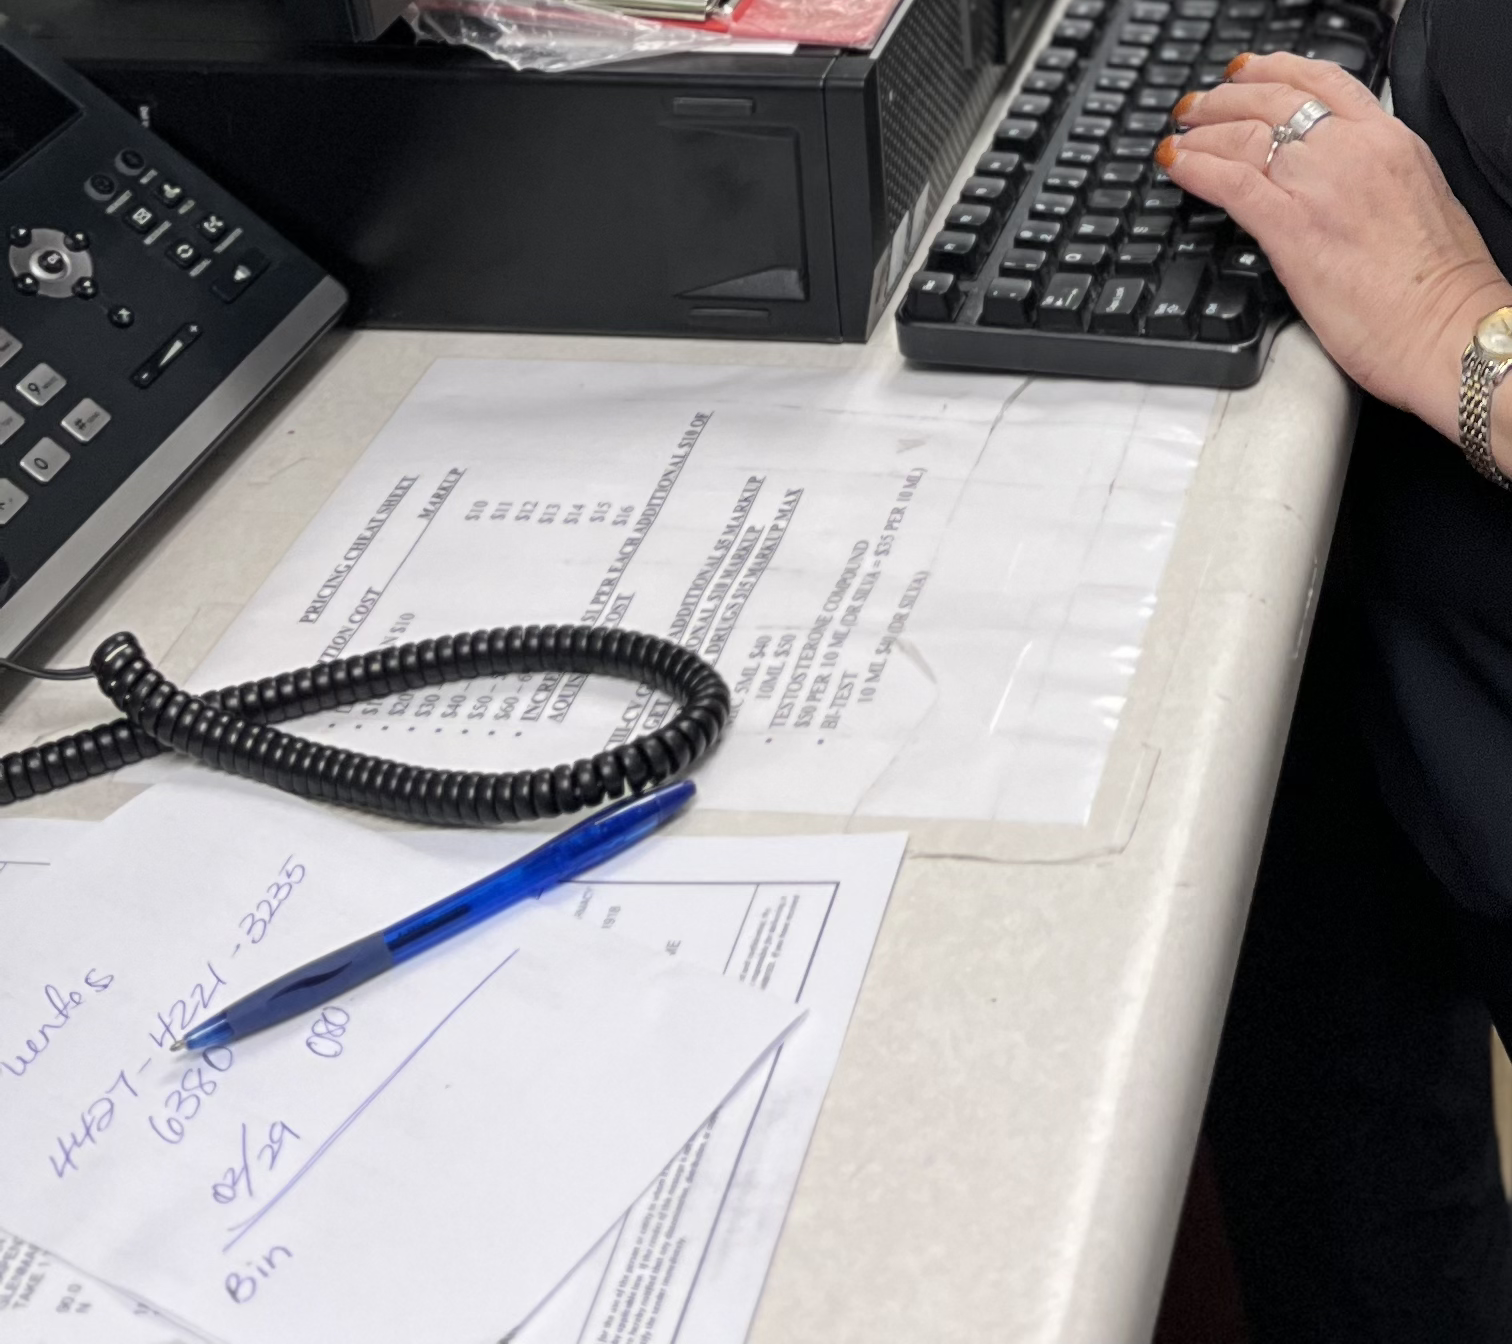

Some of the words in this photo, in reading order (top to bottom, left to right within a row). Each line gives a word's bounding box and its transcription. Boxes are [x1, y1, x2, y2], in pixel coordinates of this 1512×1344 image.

[28, 383, 40, 395] 9
[34, 458, 48, 470] 0
[464, 500, 489, 520] $10
[490, 501, 513, 520] $11
[514, 501, 538, 521] $12
[298, 564, 350, 624] PRICING
[344, 515, 382, 564] CHEAT
[376, 475, 418, 522] SHEET
[348, 586, 381, 624] COST
[417, 467, 466, 521] MARKUP
[414, 694, 440, 717] $30
[538, 503, 561, 524] $13
[441, 695, 467, 718] $40
[563, 504, 585, 524] $14
[467, 695, 493, 720] $50
[589, 502, 612, 523] $15
[494, 696, 519, 721] $60
[612, 505, 635, 526] $16
[521, 672, 561, 721] INCRE
[590, 574, 616, 607] PER
[608, 536, 640, 574] EACH
[633, 453, 688, 538] ADDITIONAL
[678, 429, 700, 451] $10
[667, 554, 722, 639] ADDITIONAL
[721, 475, 766, 540] MARKUP
[704, 599, 745, 658] DRUGS
[750, 523, 787, 583] MARKUP
[774, 487, 804, 523] MAX
[806, 672, 831, 703] PER
[821, 651, 839, 668] 10
[884, 506, 908, 531] PER
[390, 612, 415, 634] $10
[547, 673, 589, 723] AQUIS
[605, 592, 635, 623] OST
[643, 699, 671, 730] GET
[720, 525, 764, 584] MARKUP
[756, 661, 785, 700] 10ML
[769, 614, 833, 729] TESTOSTERONE
[823, 539, 870, 613] COMPOUND
[858, 686, 876, 704] 10
[820, 670, 859, 730] BI-TEST
[0, 968, 114, 1077] uentes
